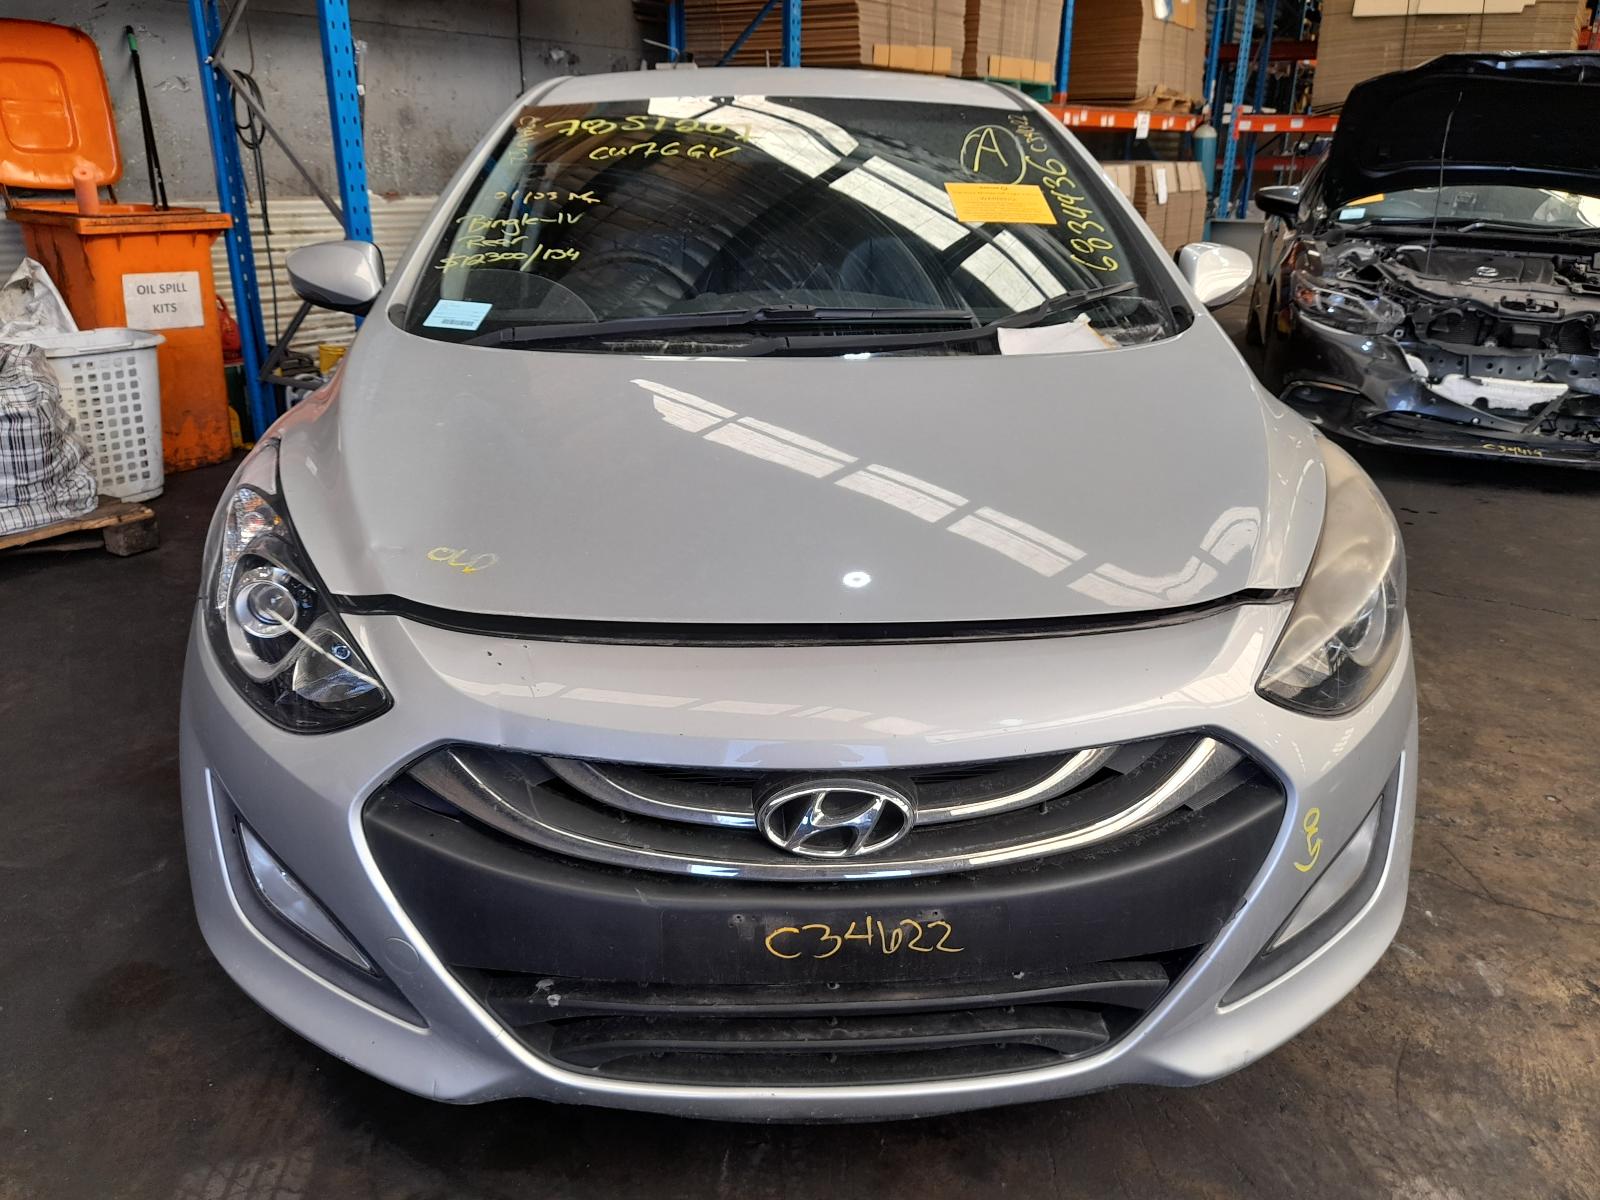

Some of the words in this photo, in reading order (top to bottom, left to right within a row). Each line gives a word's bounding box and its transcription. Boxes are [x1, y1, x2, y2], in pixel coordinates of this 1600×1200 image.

[973, 127, 1009, 172] A
[136, 284, 156, 295] OIL
[159, 282, 188, 294] SPILL
[152, 302, 178, 314] KITS
[764, 915, 965, 959] C34622
